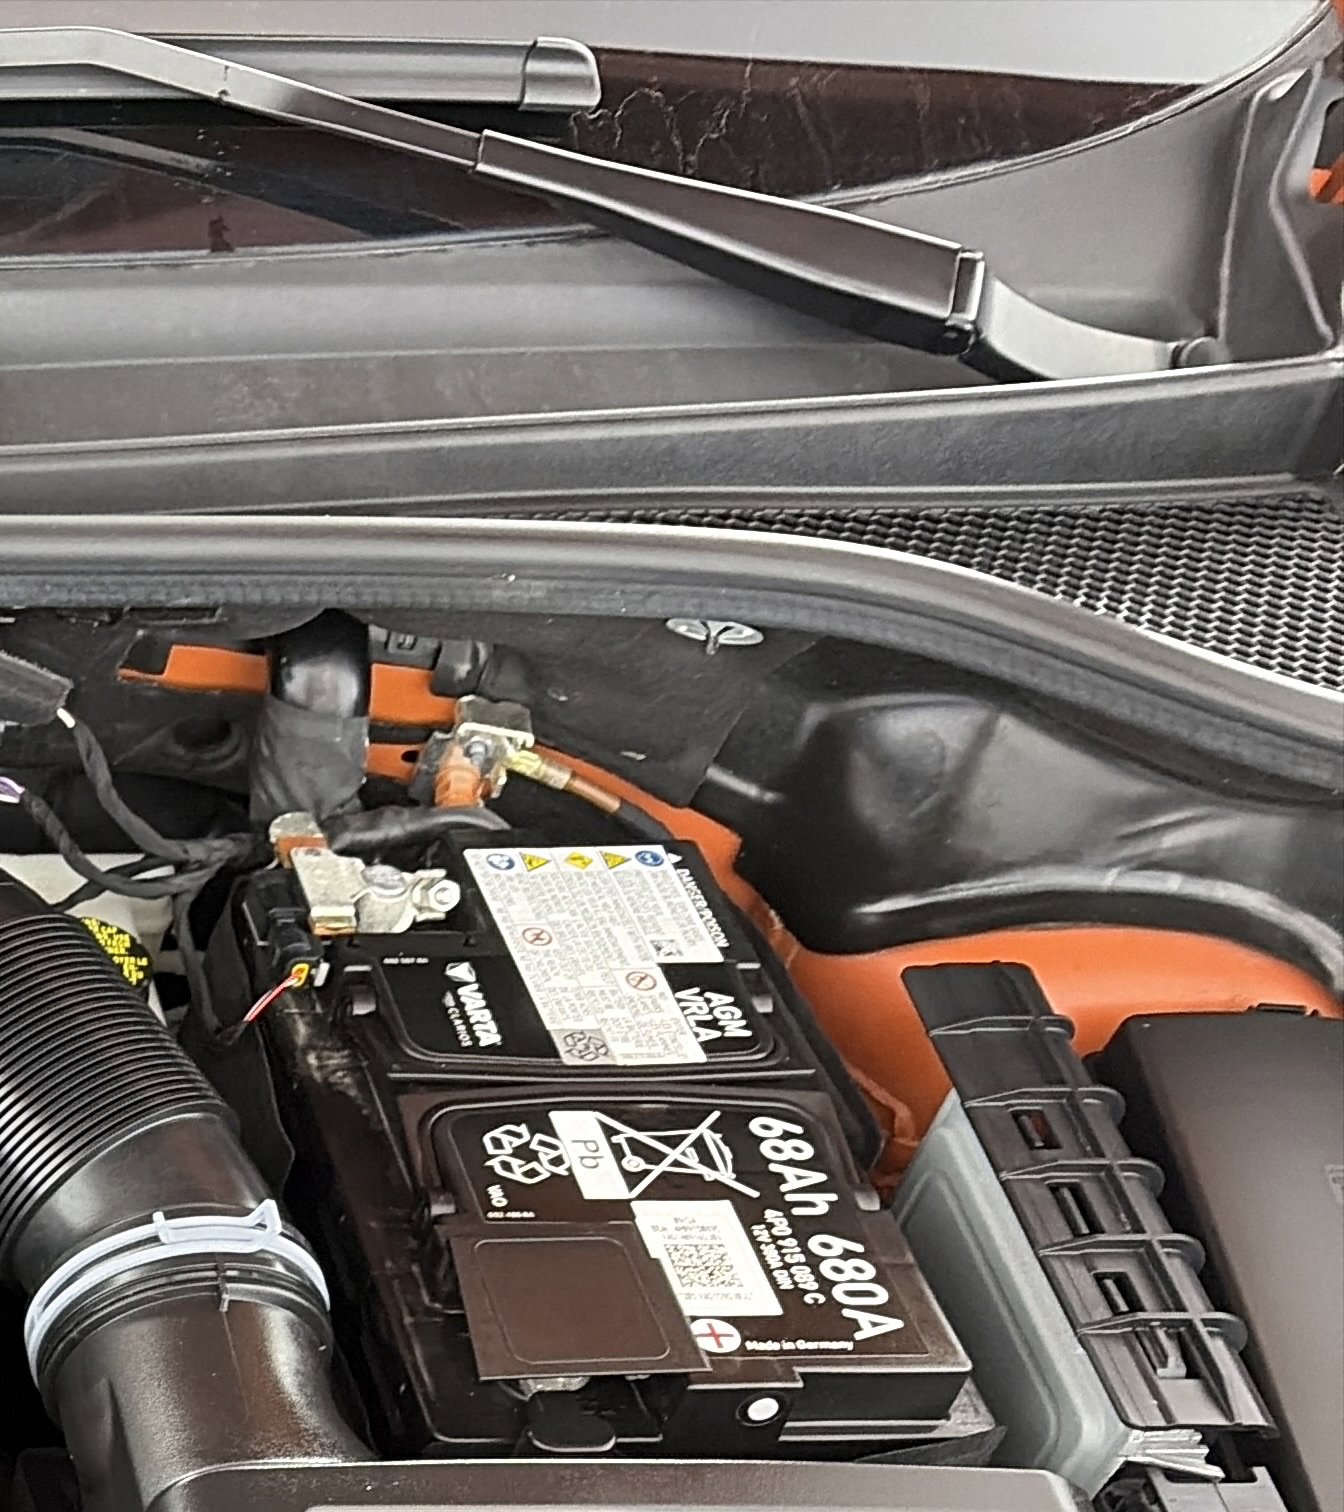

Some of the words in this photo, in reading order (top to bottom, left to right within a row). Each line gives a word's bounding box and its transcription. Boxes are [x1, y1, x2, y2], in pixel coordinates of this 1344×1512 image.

[447, 1007, 473, 1047] CLARIOS
[457, 983, 501, 1047] VARTA
[673, 987, 722, 1043] VRLA
[703, 991, 753, 1037] AGM
[571, 1140, 604, 1169] Pb
[748, 1116, 839, 1216] 68Ah
[807, 1234, 905, 1341] 680A
[777, 1237, 806, 1264] 915
[803, 1292, 826, 1305] C
[795, 1339, 854, 1351] Germany
